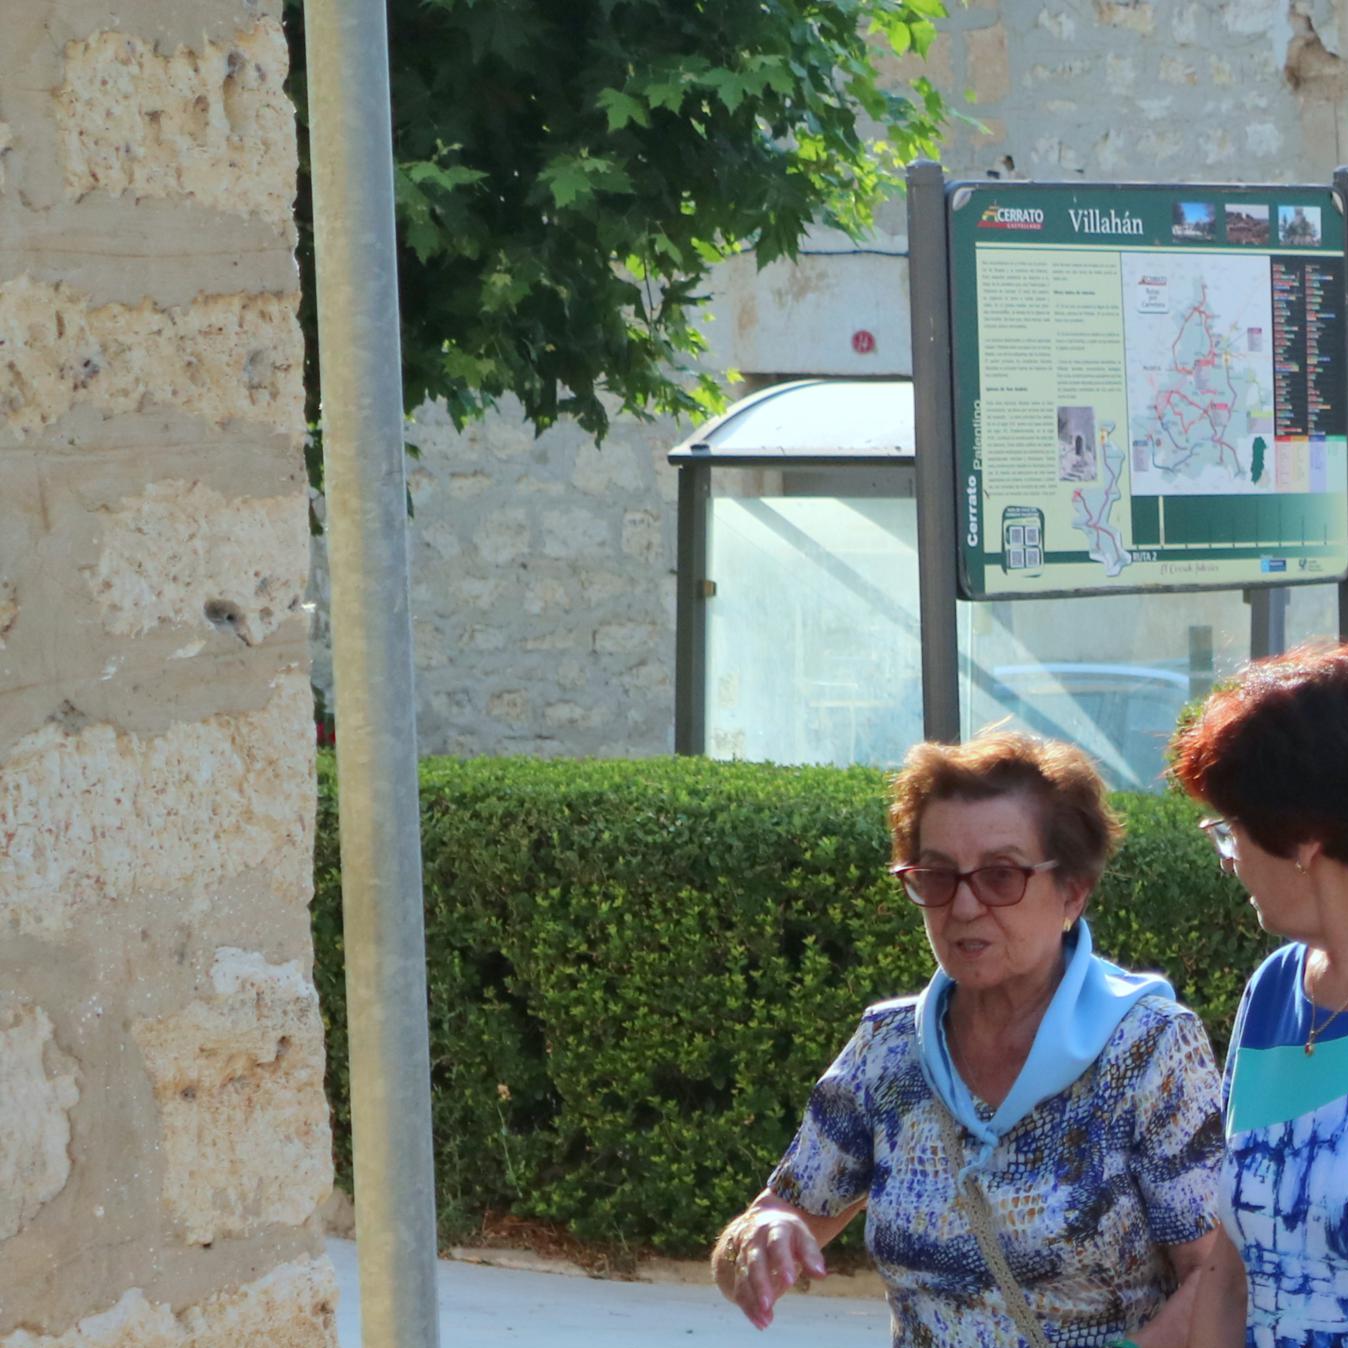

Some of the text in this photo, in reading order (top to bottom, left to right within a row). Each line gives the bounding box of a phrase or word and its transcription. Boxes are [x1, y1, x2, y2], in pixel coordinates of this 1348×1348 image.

[997, 208, 1044, 223] CERRATO
[1068, 208, 1144, 235] Villahán
[967, 475, 978, 547] Cerrato
[1152, 551, 1158, 561] 2
